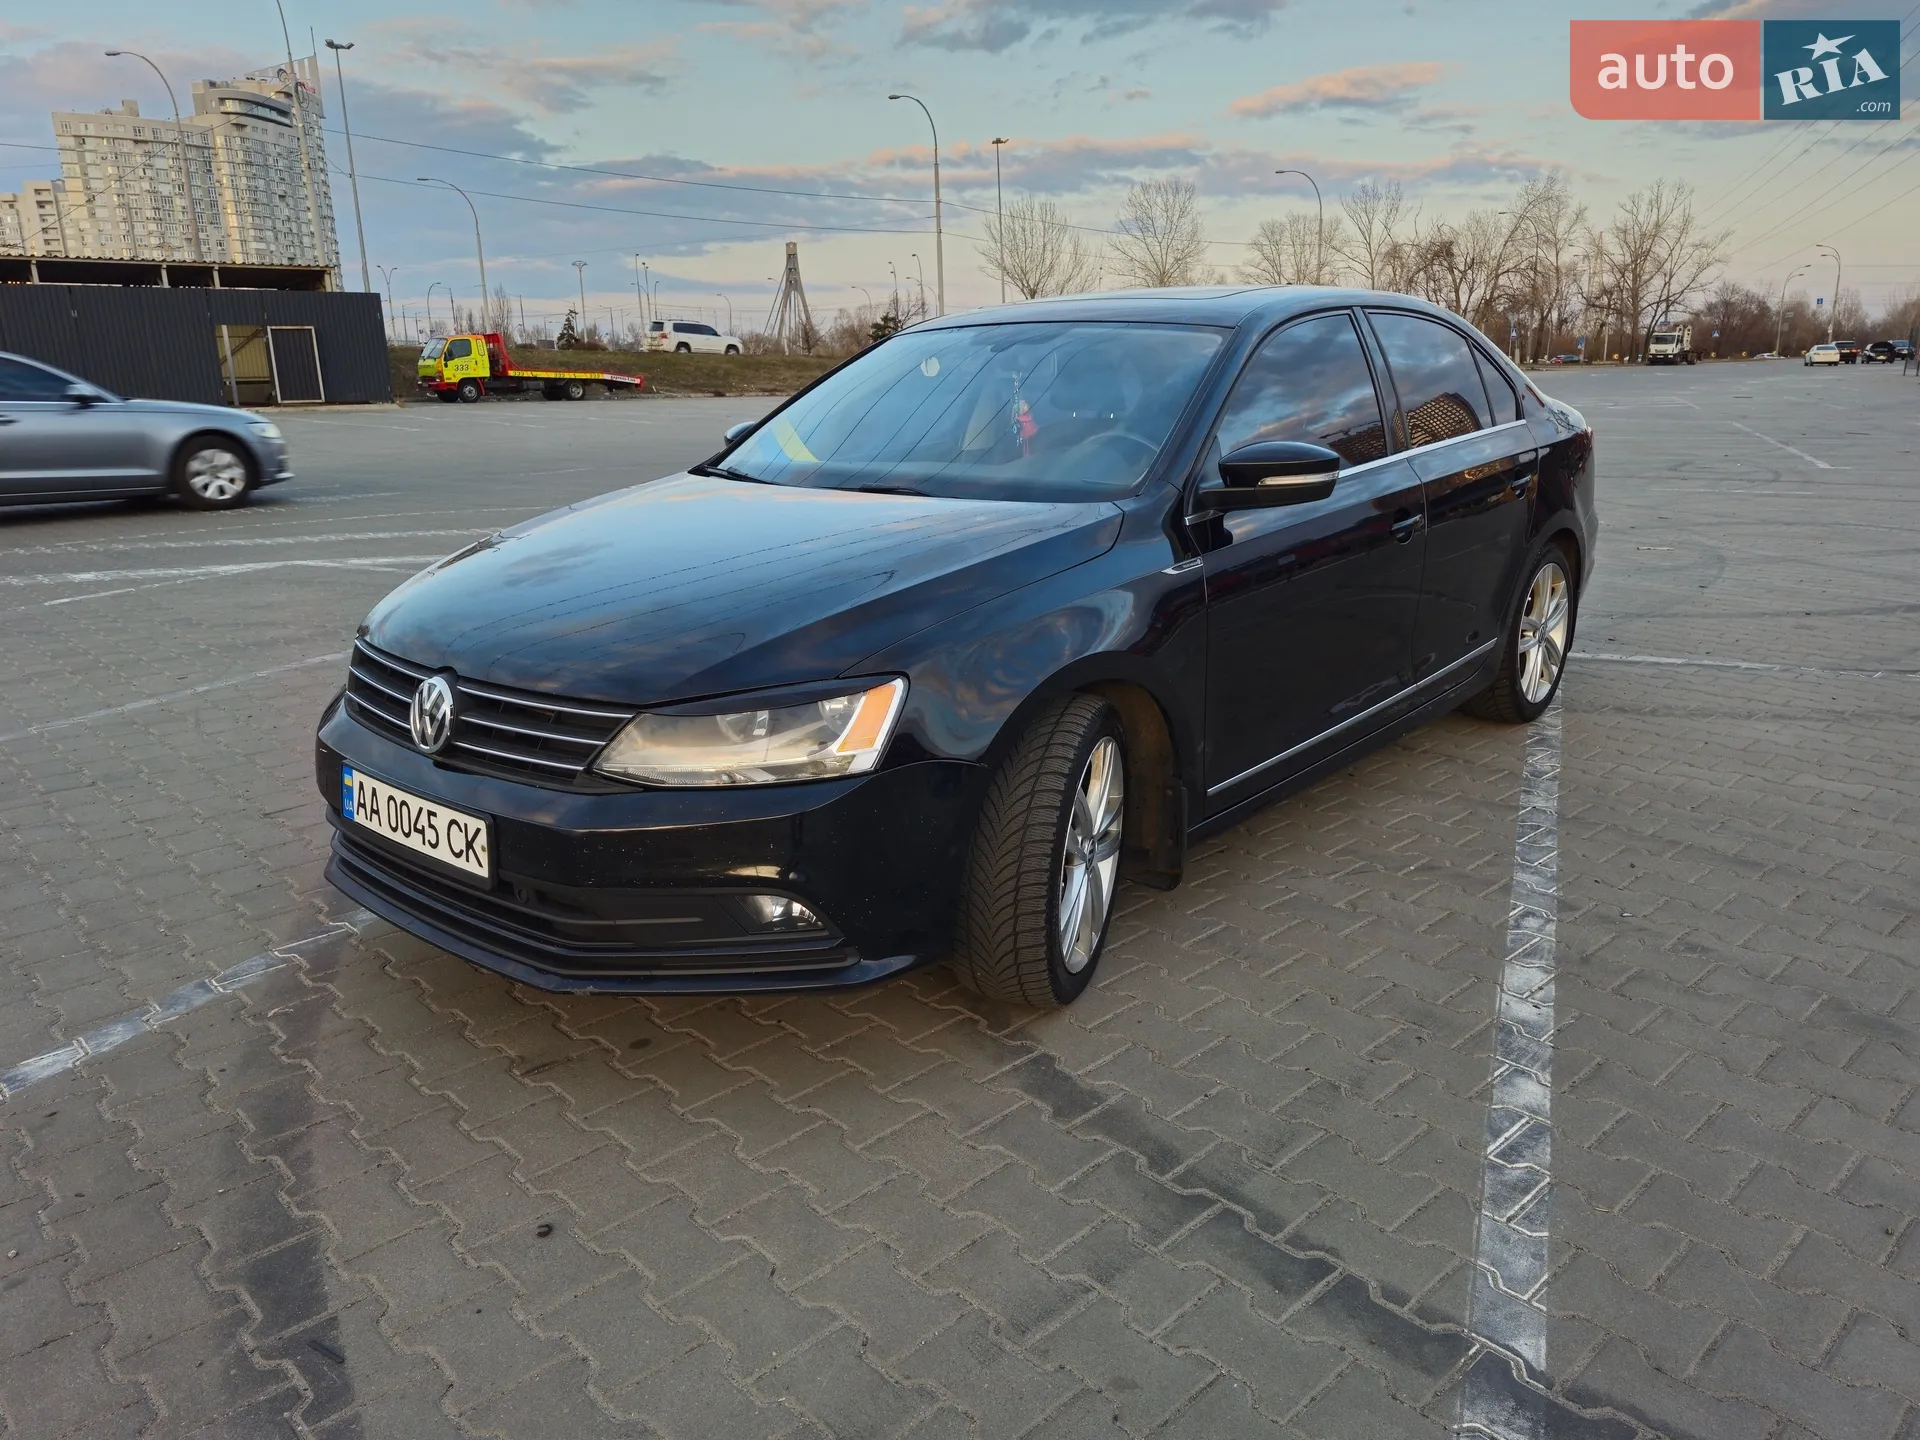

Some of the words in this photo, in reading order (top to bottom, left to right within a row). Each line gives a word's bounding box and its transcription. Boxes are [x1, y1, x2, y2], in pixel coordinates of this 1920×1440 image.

[454, 364, 470, 372] 333
[344, 798, 354, 812] UA
[356, 780, 382, 827] AA
[387, 795, 440, 849] 0045
[447, 819, 483, 869] CK
